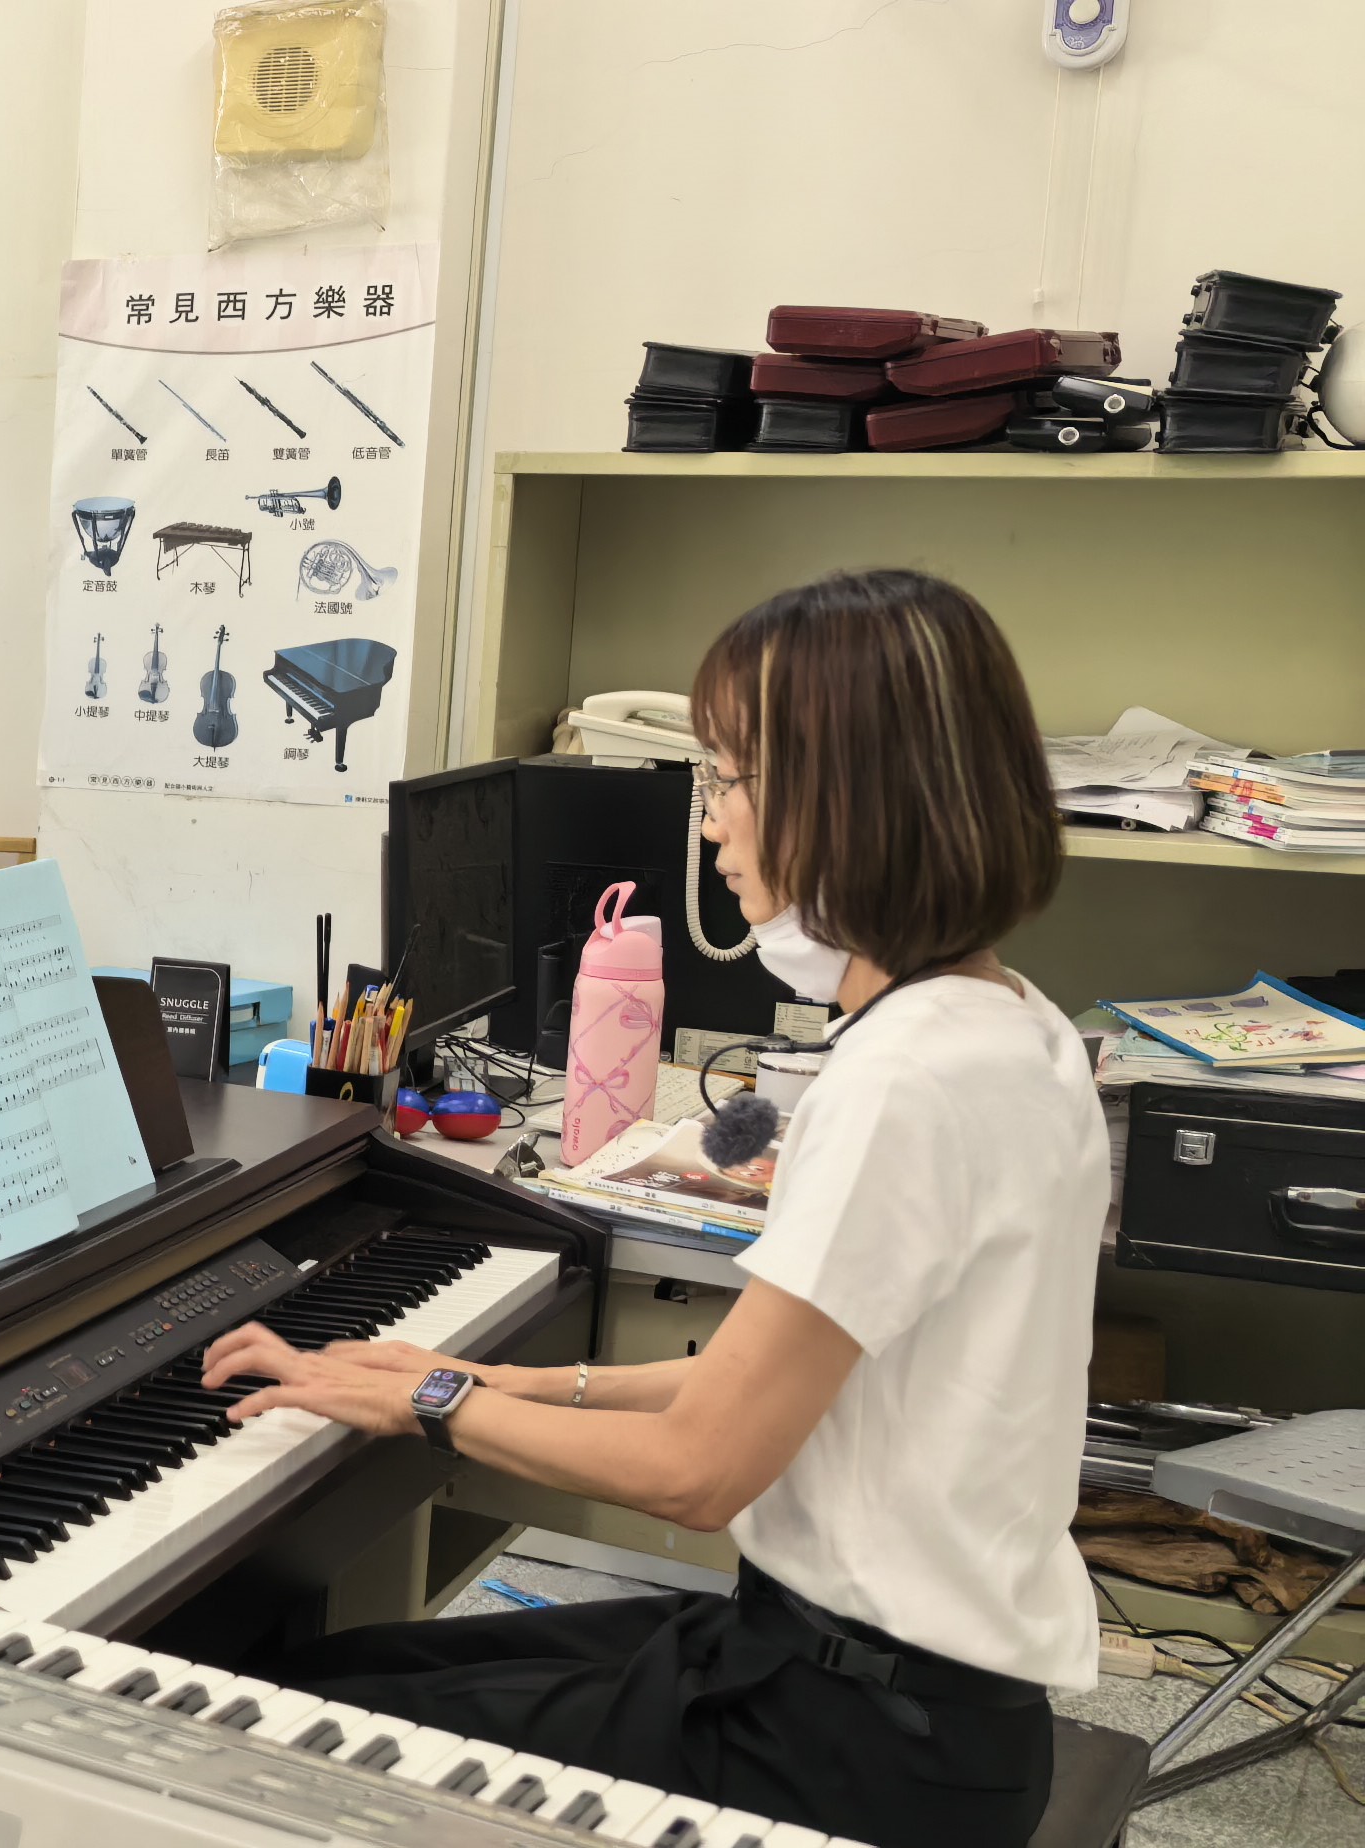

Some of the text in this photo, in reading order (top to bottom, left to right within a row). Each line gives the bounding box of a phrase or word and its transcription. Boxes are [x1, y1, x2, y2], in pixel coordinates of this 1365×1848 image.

[125, 284, 396, 326] 常見西方樂器
[111, 447, 148, 462] 單簧管
[205, 448, 230, 462] 長笛
[272, 447, 311, 461] 雙簧管
[352, 446, 392, 460] 低音管
[289, 518, 315, 532] 小號
[82, 580, 118, 594] 定音鼓
[190, 581, 217, 595] 木琴
[314, 601, 354, 615] 法國號
[74, 705, 111, 719] 小提琴
[133, 709, 171, 723] 中提琴
[283, 747, 310, 761] 鋼琴
[193, 755, 231, 769] 大提琴
[160, 997, 209, 1010] SNUGGLE
[572, 1117, 581, 1151] owala
